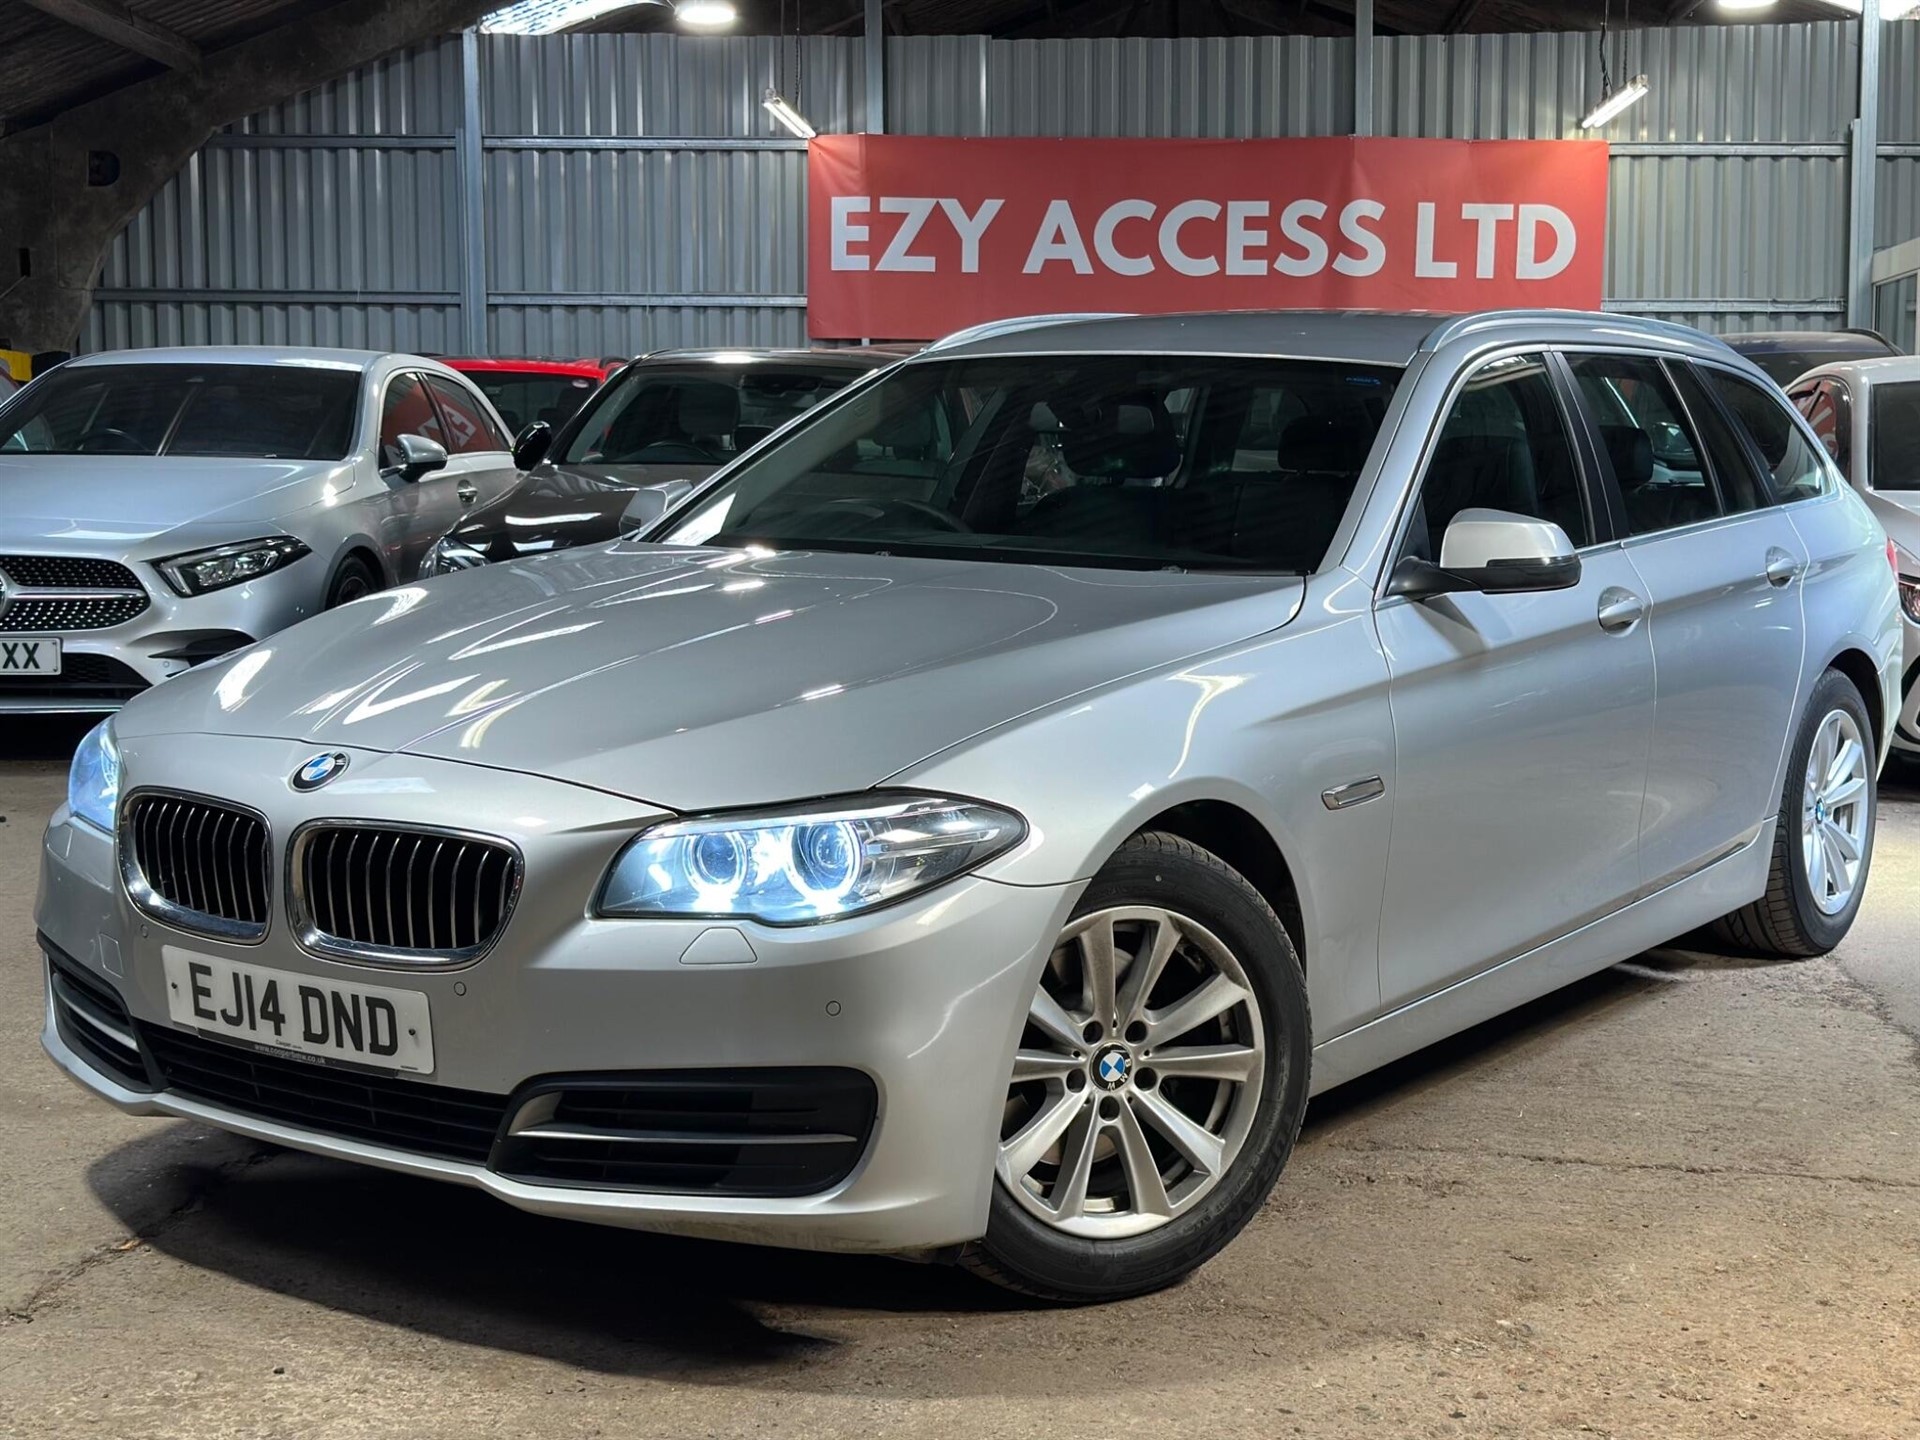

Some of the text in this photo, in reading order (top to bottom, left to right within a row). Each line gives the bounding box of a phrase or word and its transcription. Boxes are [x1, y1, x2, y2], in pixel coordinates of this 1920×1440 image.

[830, 196, 1578, 280] EZY ACCESS LTD
[189, 961, 398, 1057] EJ14 DND
